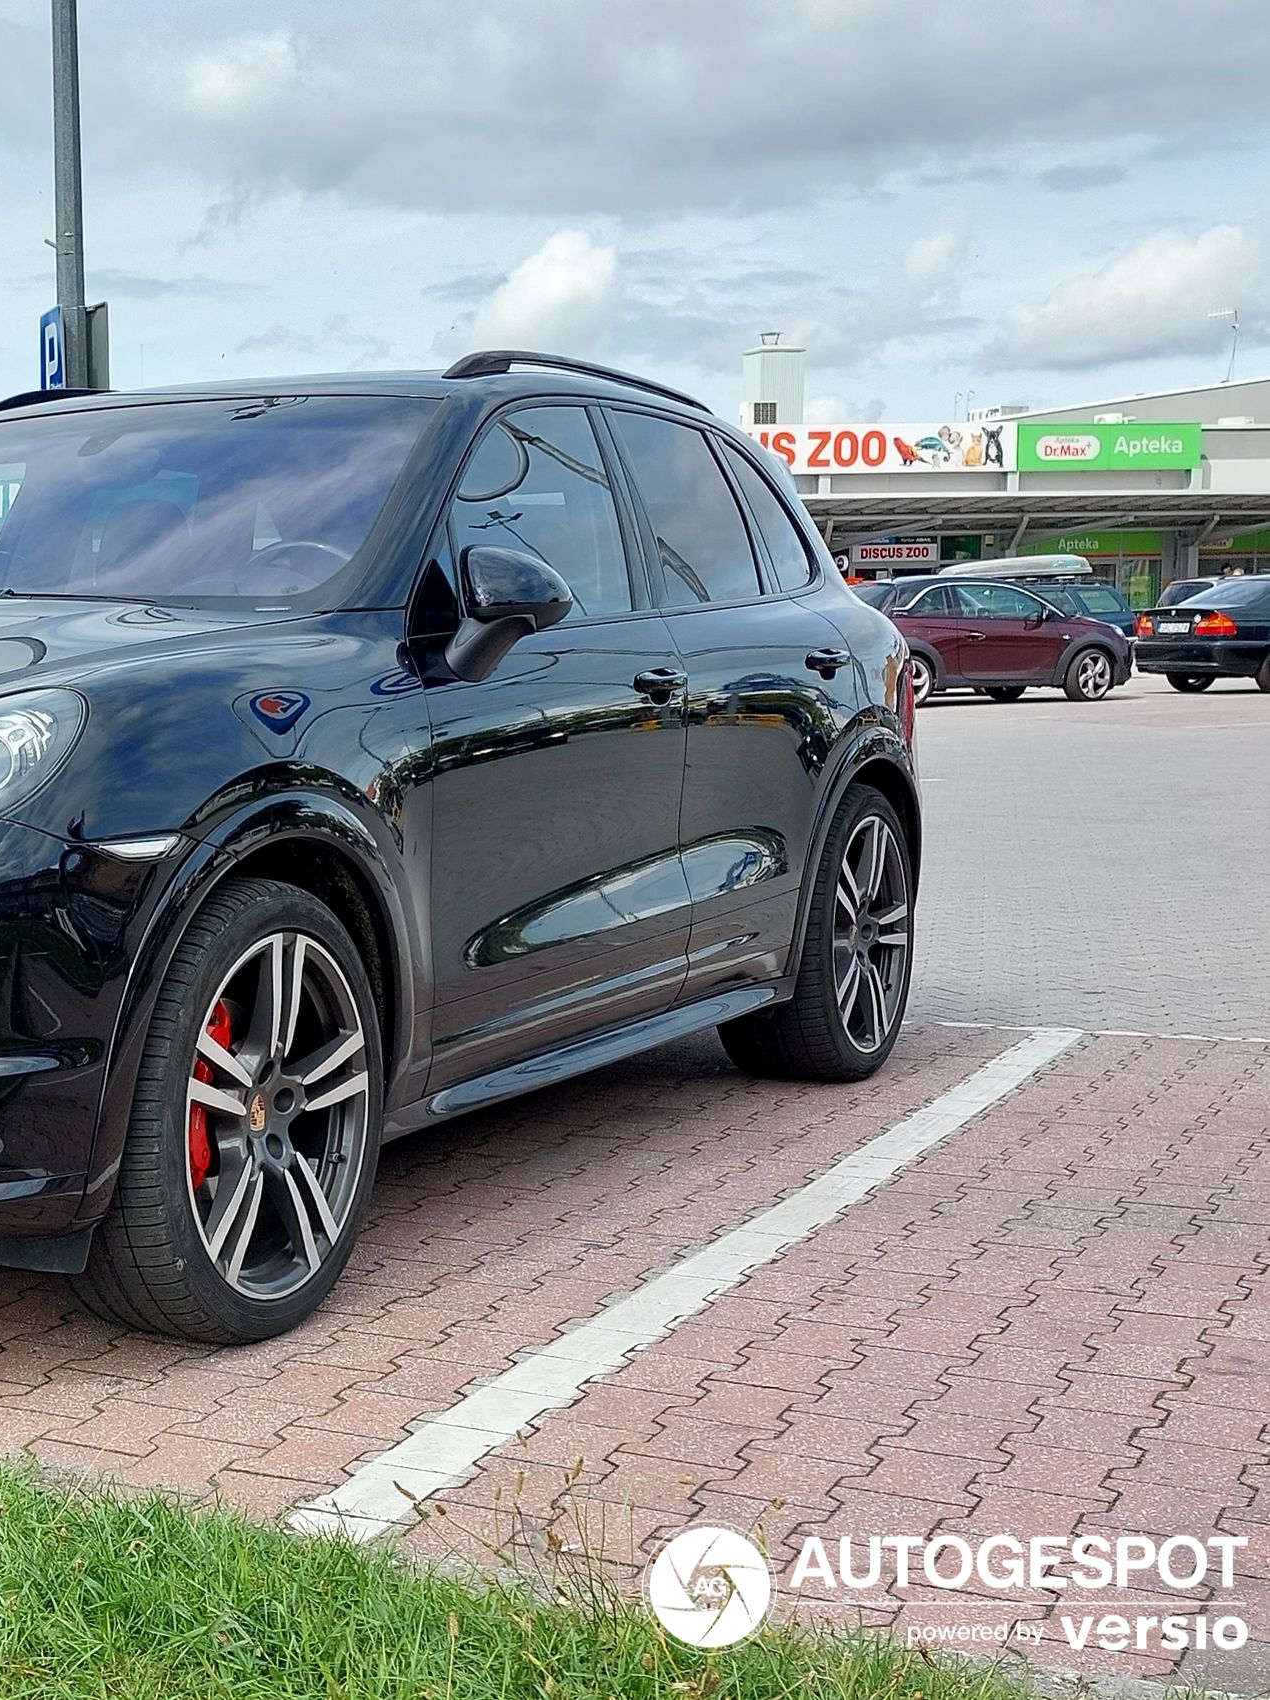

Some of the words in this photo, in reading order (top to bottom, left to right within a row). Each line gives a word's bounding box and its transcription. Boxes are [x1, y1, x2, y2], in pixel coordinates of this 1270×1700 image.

[807, 430, 887, 468] ZOO
[1114, 436, 1183, 457] Apteka
[860, 547, 903, 559] DISCUS
[906, 546, 929, 558] ZOO
[1058, 537, 1099, 552] Apteka
